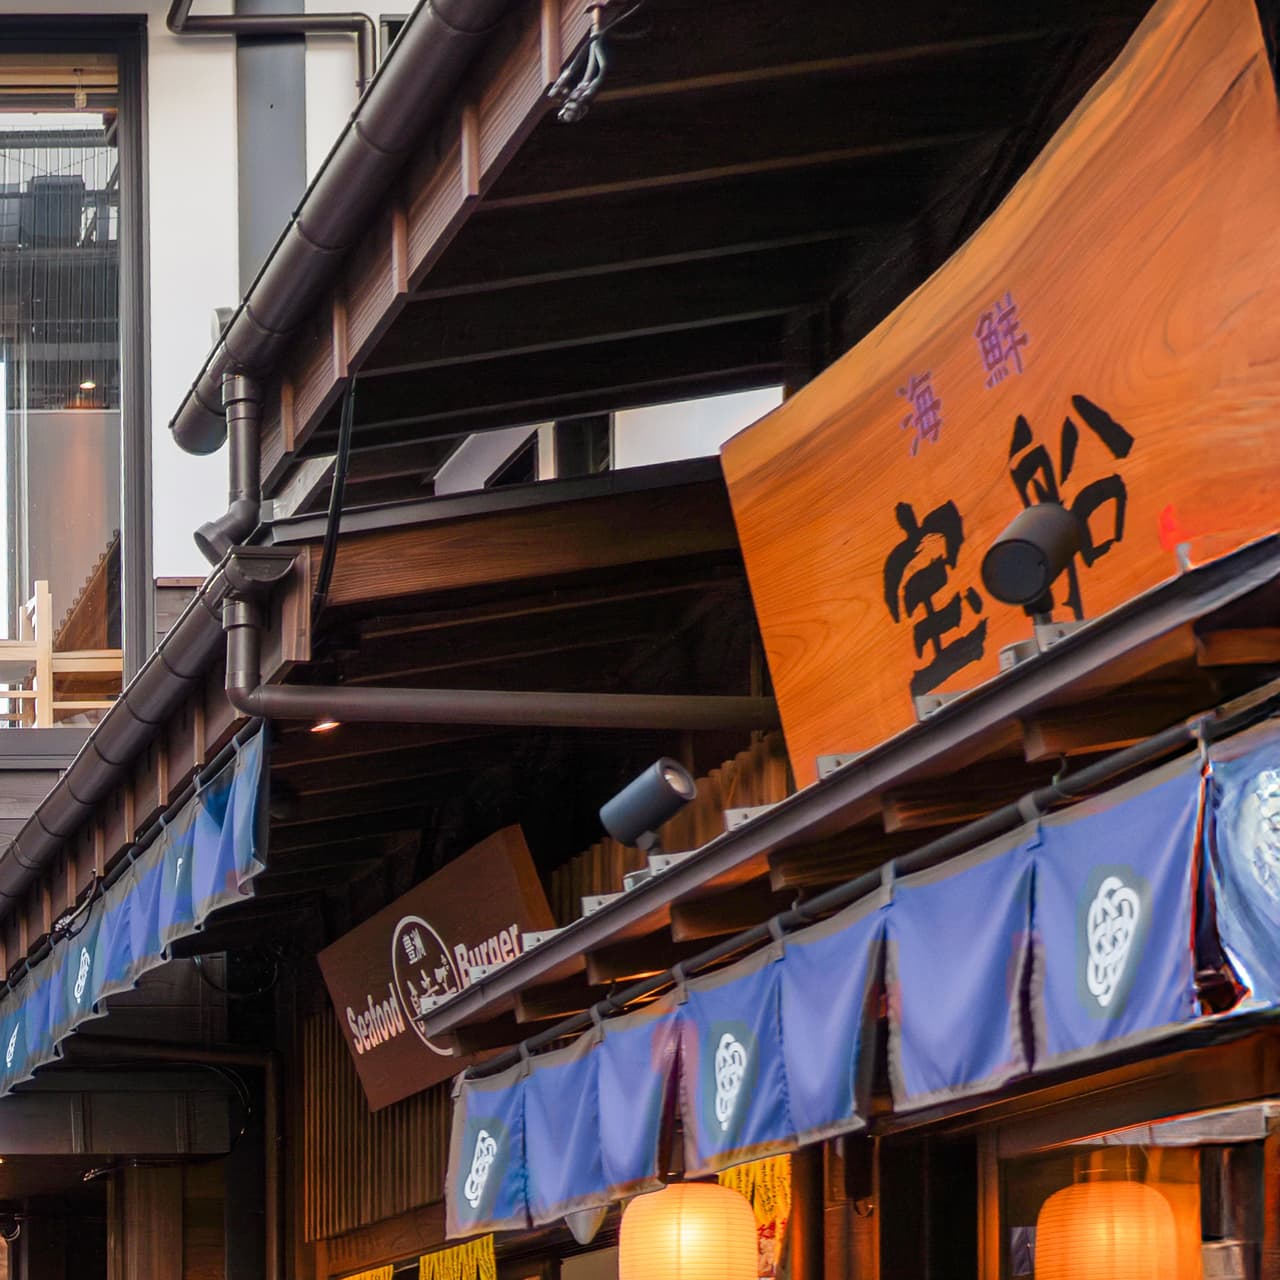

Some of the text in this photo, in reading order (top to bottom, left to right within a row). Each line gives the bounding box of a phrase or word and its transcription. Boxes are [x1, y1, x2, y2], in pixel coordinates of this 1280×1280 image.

[896, 291, 1029, 457] 海鮮
[883, 394, 1134, 698] 宝船
[346, 983, 406, 1054] Seafood
[454, 924, 519, 990] Burger
